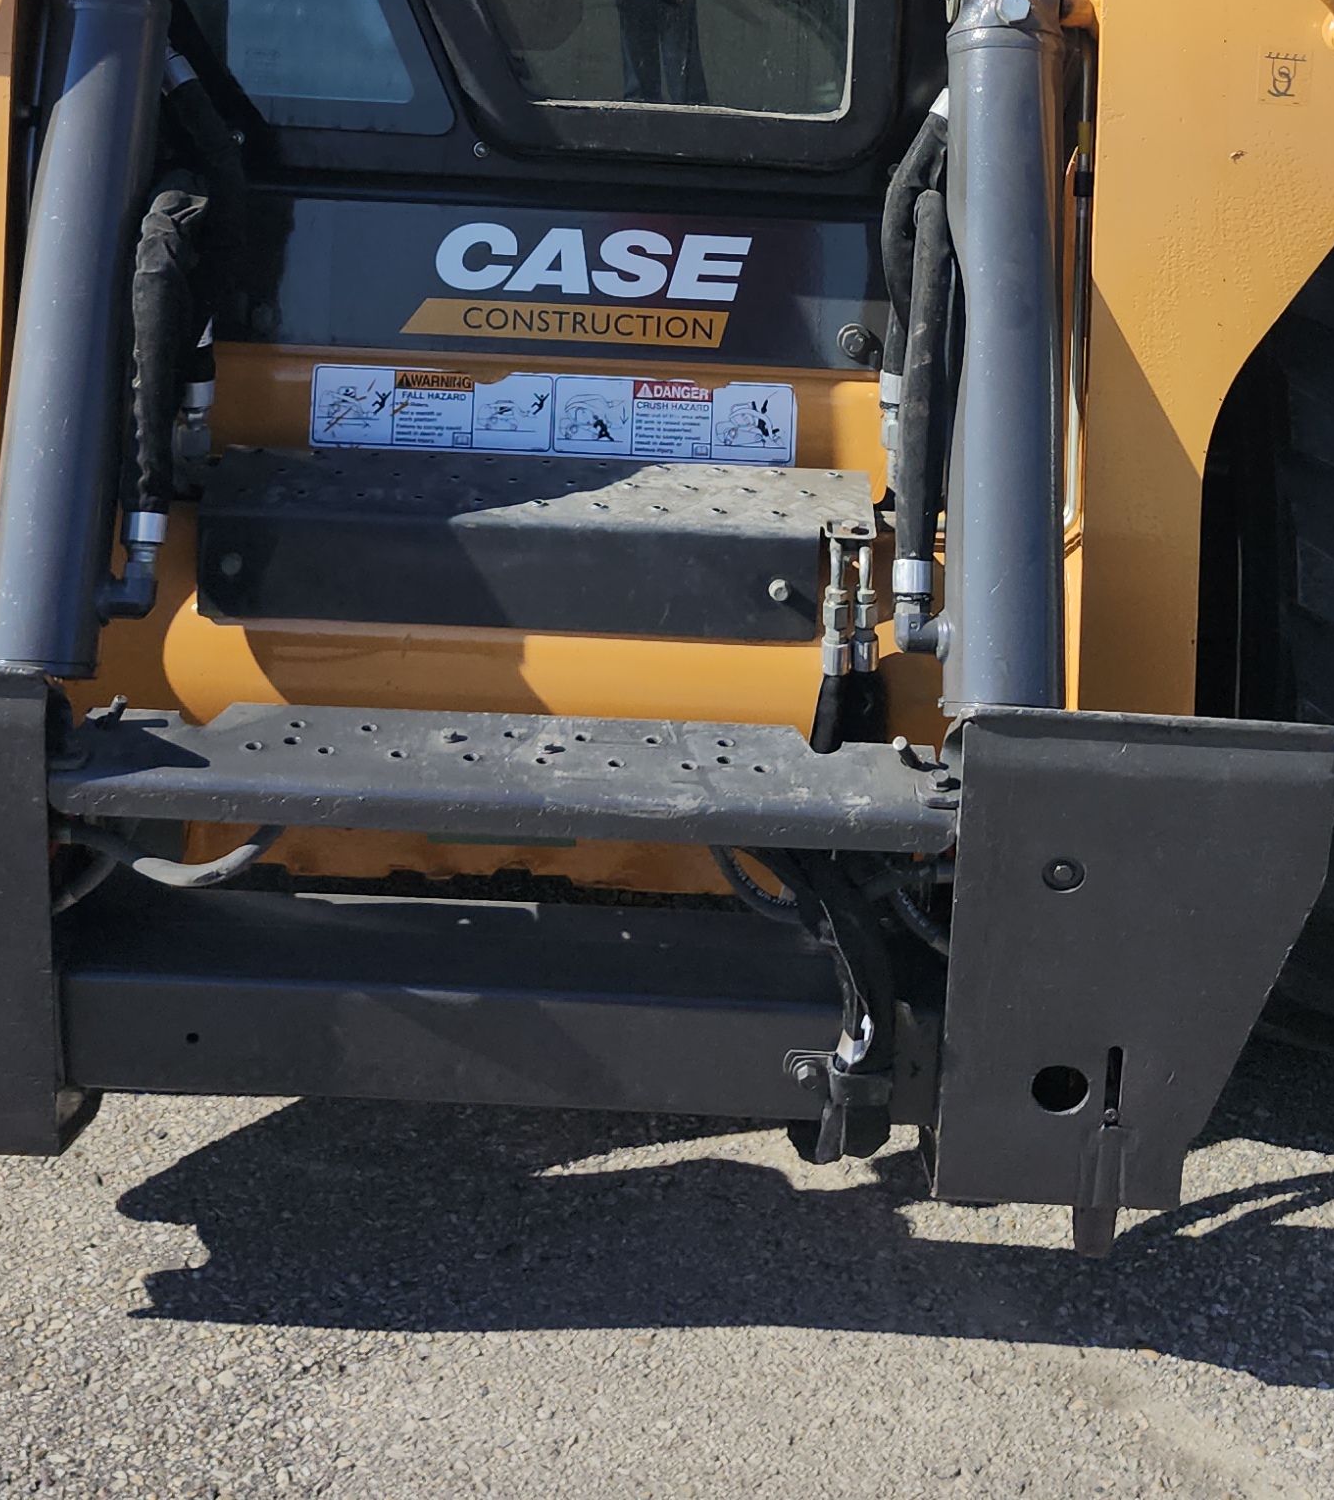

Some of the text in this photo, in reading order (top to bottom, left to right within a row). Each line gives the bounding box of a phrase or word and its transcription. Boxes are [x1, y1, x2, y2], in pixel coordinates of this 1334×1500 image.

[435, 222, 752, 302] CASE
[462, 305, 714, 341] CONSTRUCTION
[410, 374, 472, 389] WARNING
[402, 391, 467, 401] FALL HAZARD
[653, 385, 709, 401] DANGER
[636, 401, 669, 410] CRUSH
